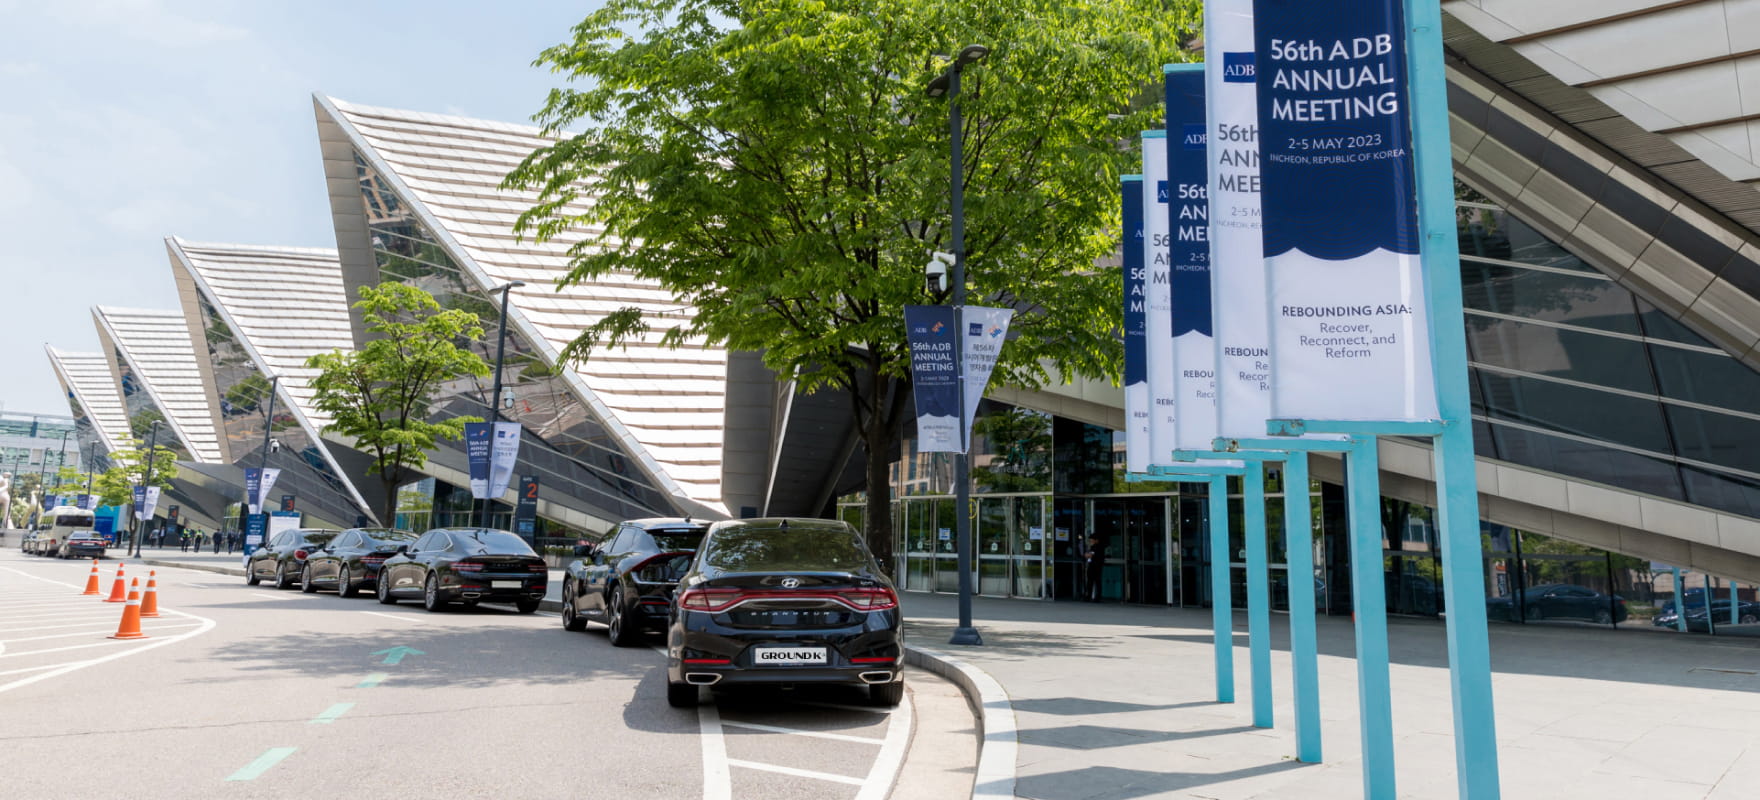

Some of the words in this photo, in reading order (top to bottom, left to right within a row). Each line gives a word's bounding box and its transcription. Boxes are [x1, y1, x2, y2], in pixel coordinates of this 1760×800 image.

[1271, 38, 1324, 61] 56th
[1328, 34, 1392, 61] ADB
[1224, 64, 1256, 77] ADB
[1272, 63, 1395, 92] ANNUAL
[1272, 92, 1398, 122] MEETING
[1288, 138, 1309, 150] 2-5
[1312, 138, 1343, 150] MAY
[1347, 133, 1383, 148] 2023
[1269, 153, 1311, 165] INCHEON,
[1312, 154, 1356, 165] REPUBLIC
[1358, 152, 1372, 163] OF
[1373, 149, 1406, 161] KOREA
[1282, 305, 1372, 318] REBOUNDING
[1375, 304, 1412, 316] ASIA:
[1319, 322, 1373, 334] Recover,
[912, 342, 931, 352] 56th
[931, 342, 951, 352] ADB
[1299, 335, 1370, 347] Reconnect,
[1372, 333, 1396, 345] and
[914, 353, 952, 362] ANNUAL
[1325, 347, 1371, 359] Reform
[914, 362, 954, 372] MEETING
[527, 483, 538, 498] 2
[286, 500, 295, 511] 3
